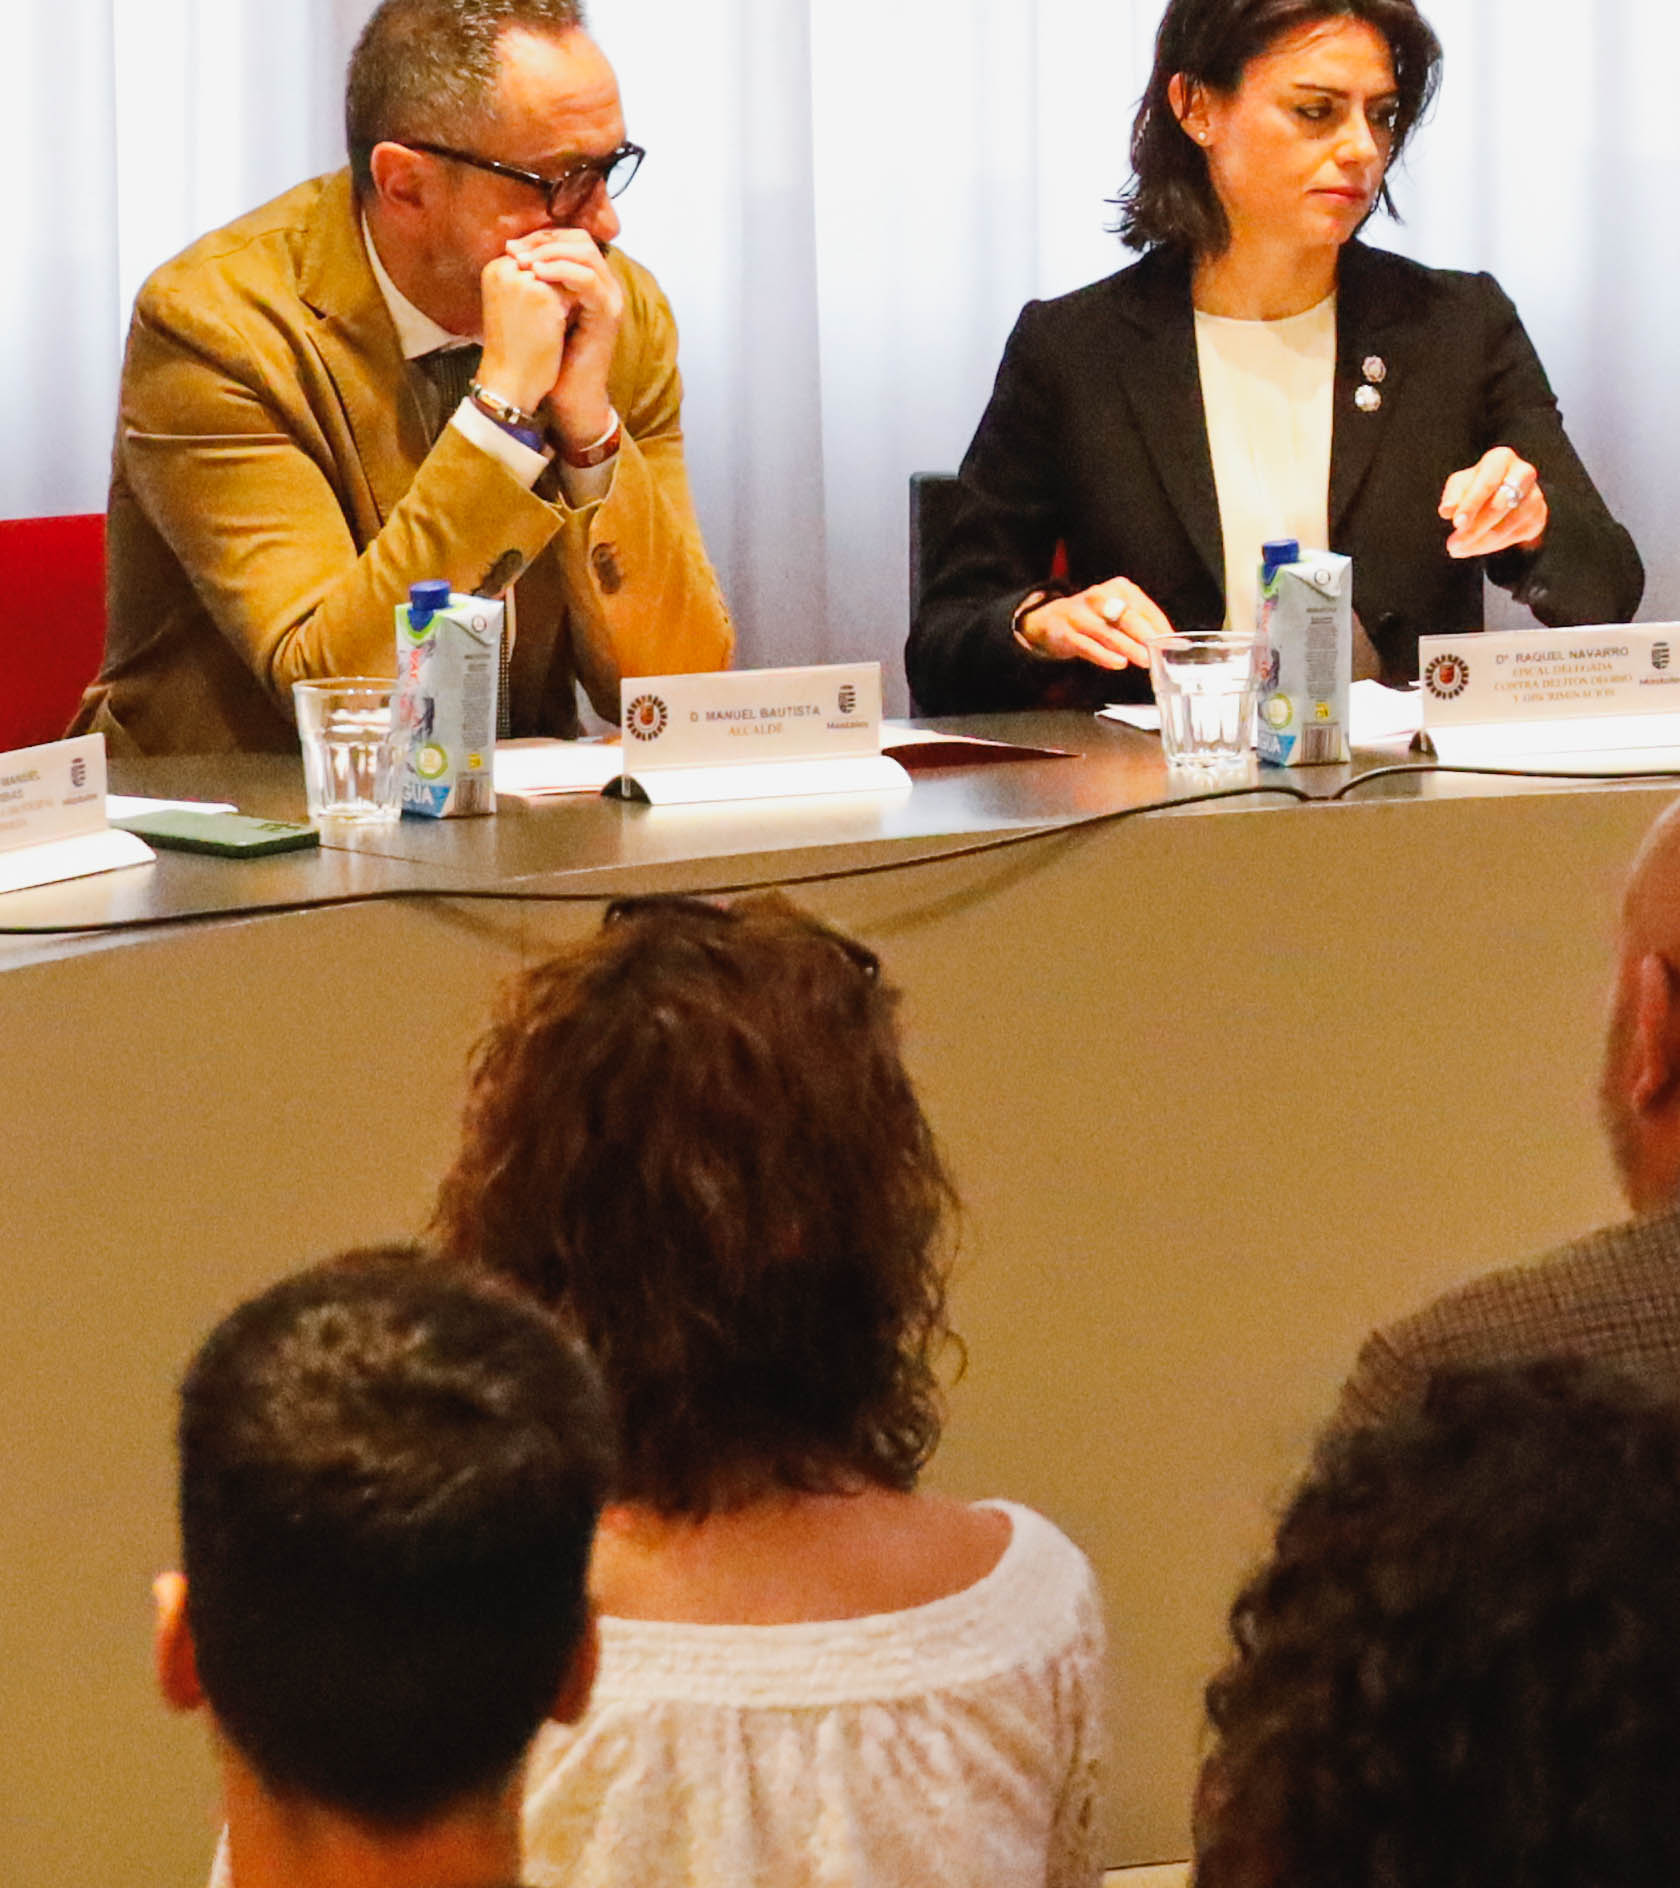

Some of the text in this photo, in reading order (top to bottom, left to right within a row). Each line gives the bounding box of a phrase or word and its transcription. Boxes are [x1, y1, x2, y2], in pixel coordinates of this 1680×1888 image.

[1568, 646, 1630, 660] NAVARRO
[706, 708, 756, 722] MANUEL
[759, 704, 821, 719] BAUTISTA
